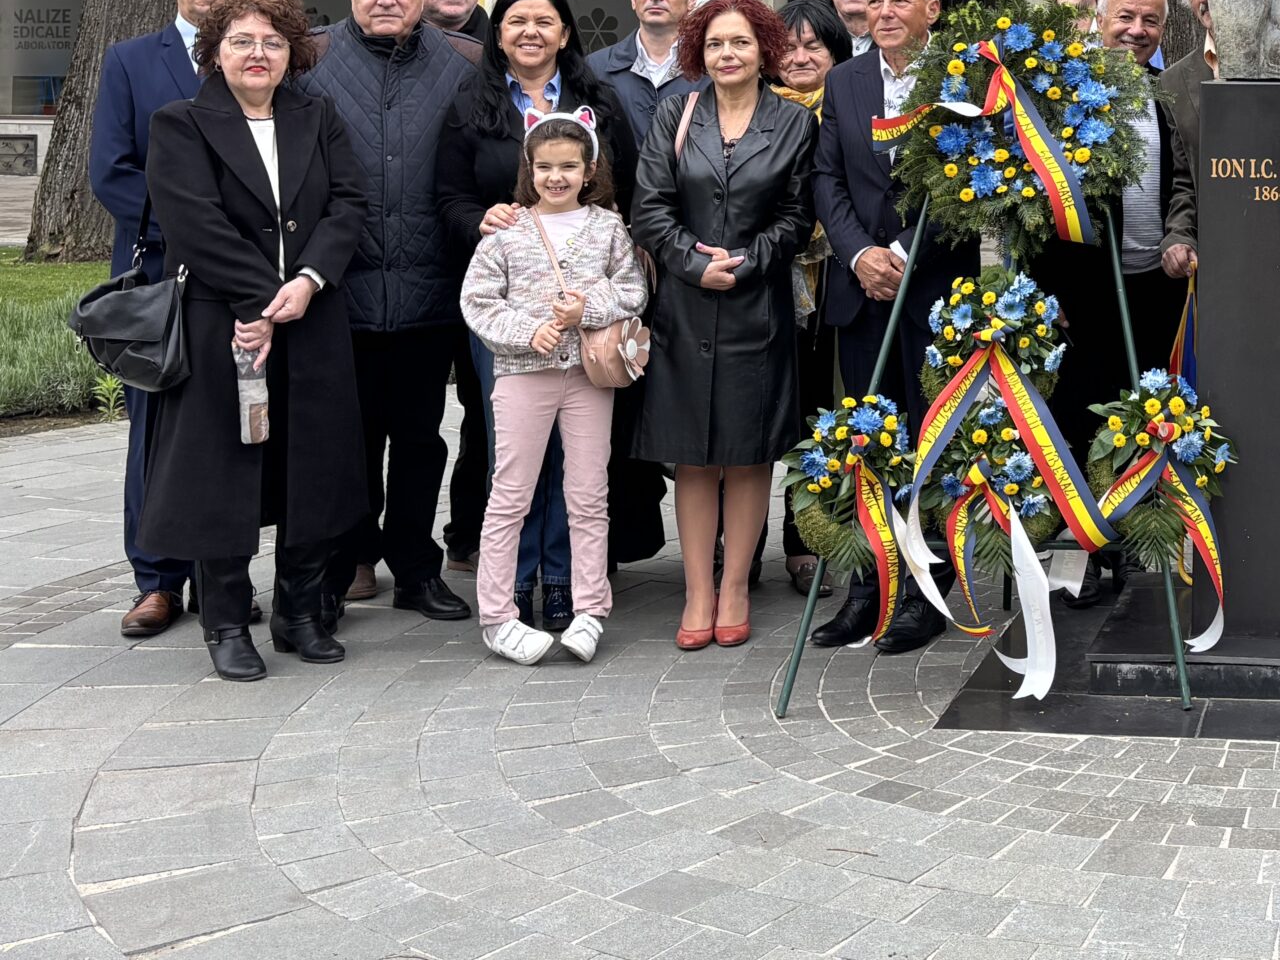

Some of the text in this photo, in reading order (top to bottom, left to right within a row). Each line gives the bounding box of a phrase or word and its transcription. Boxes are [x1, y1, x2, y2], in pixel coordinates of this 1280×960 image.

[14, 8, 72, 23] NALIZE
[13, 26, 72, 38] EDICALE
[16, 41, 71, 50] ABORATOR
[1210, 158, 1245, 178] ION
[1250, 158, 1277, 179] I.C.
[1056, 176, 1076, 212] MARE
[1039, 443, 1080, 501] LIBERALI
